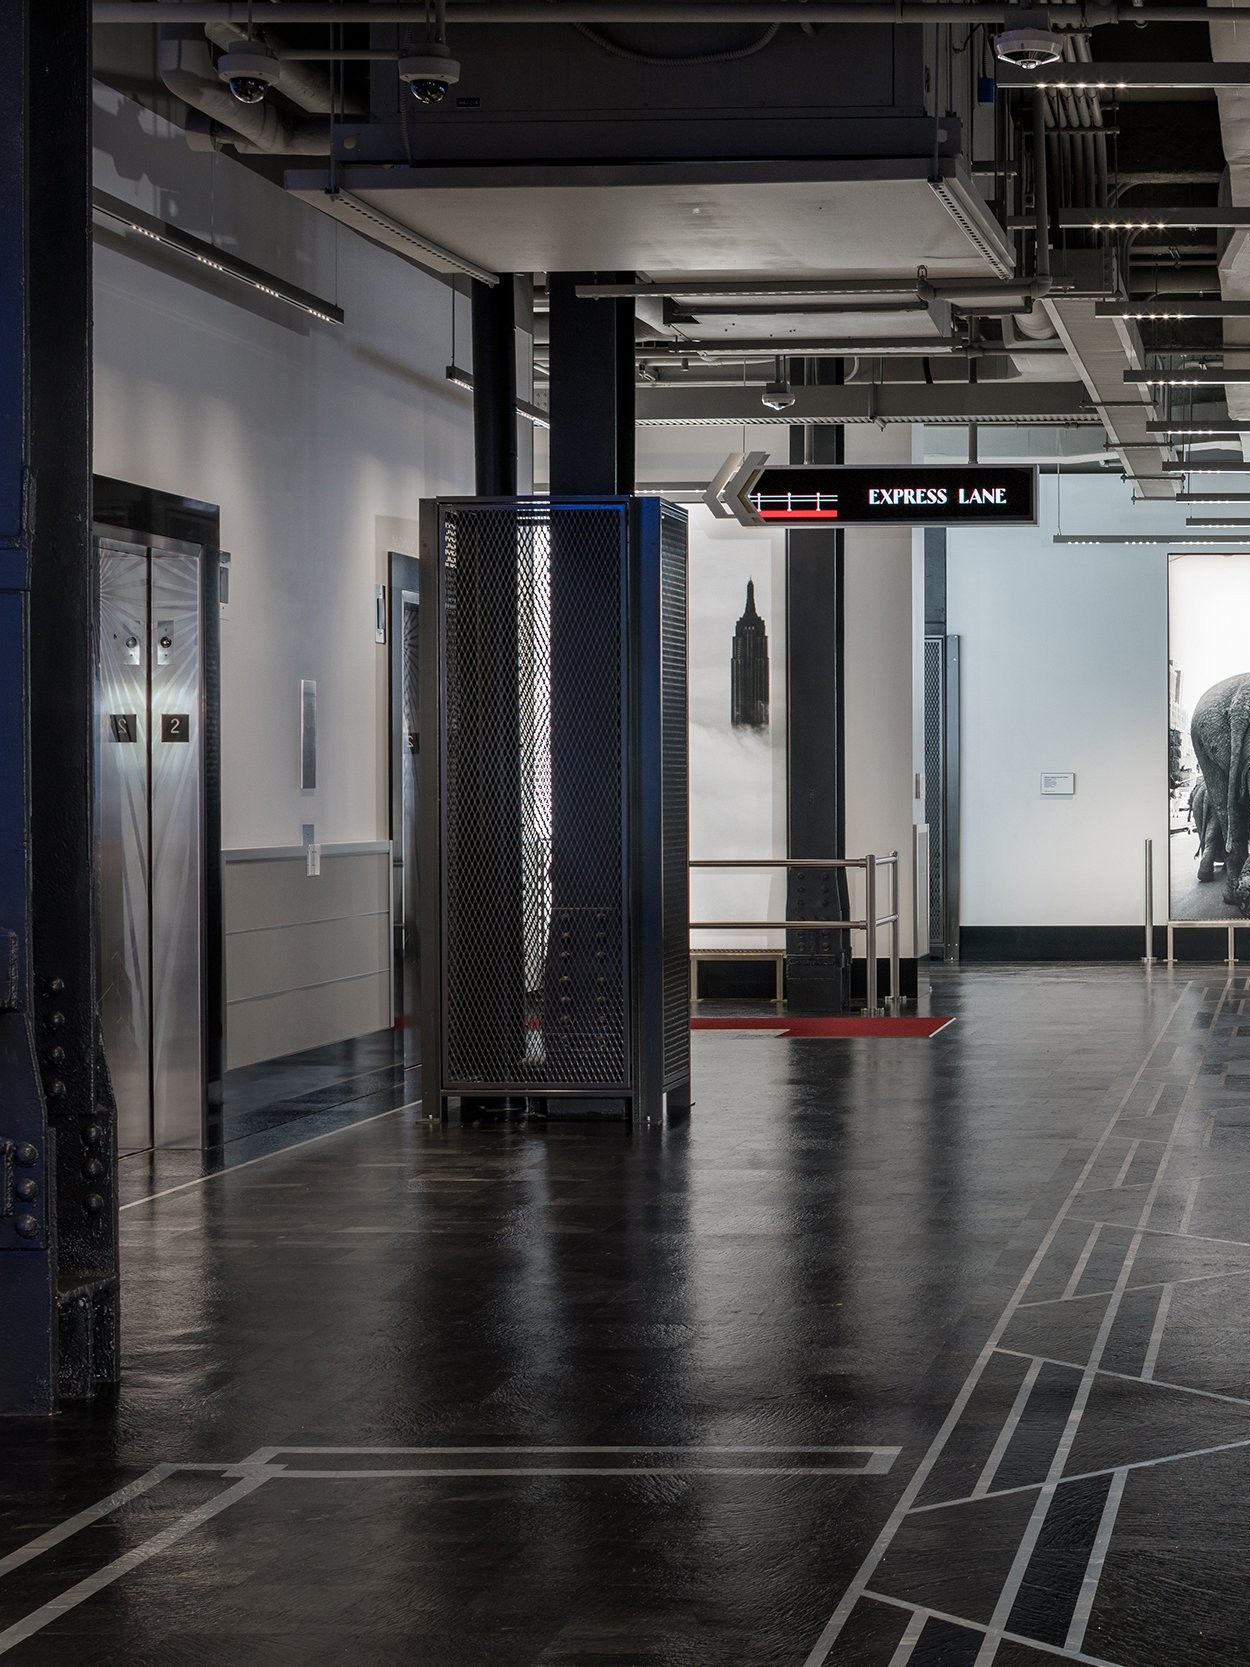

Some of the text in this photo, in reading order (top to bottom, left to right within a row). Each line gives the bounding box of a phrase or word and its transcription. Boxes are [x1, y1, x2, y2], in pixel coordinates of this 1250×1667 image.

[868, 488, 1007, 505] EXPRESS LANE
[170, 718, 180, 733] 2
